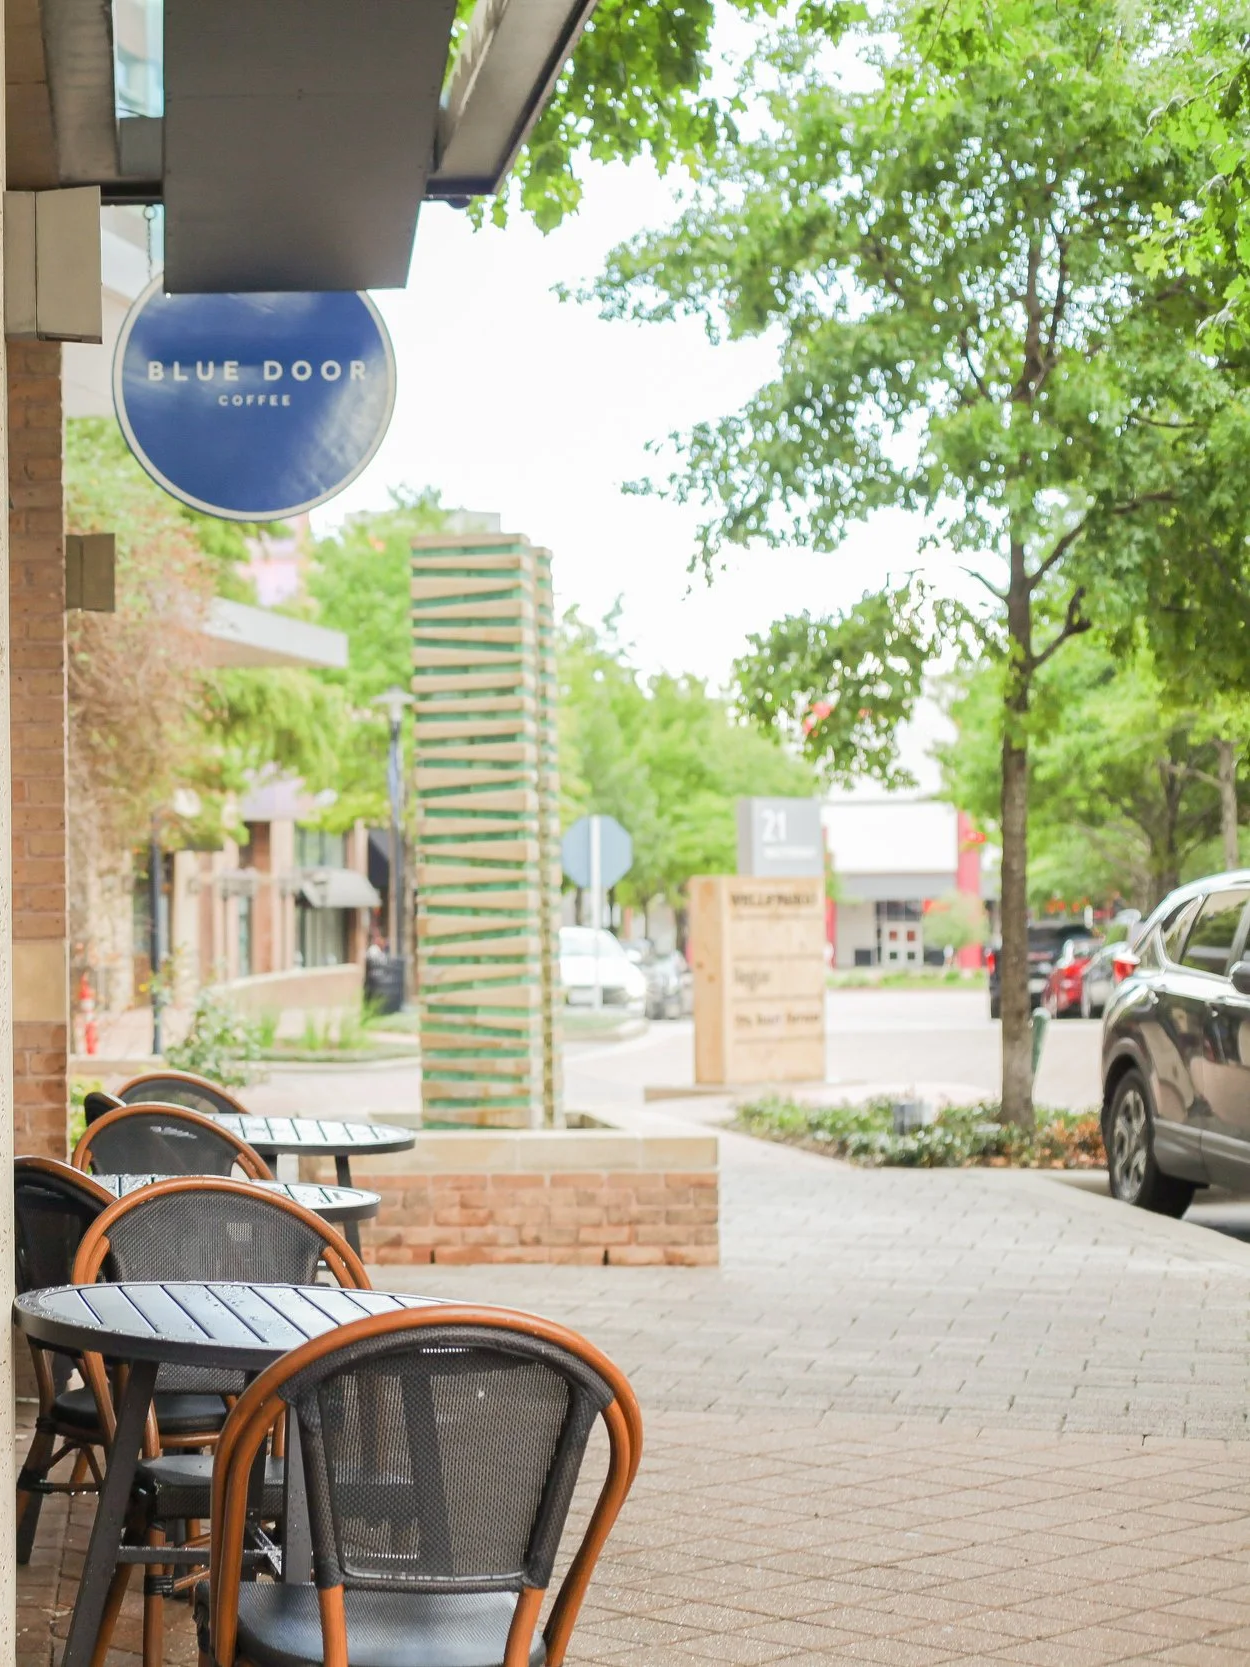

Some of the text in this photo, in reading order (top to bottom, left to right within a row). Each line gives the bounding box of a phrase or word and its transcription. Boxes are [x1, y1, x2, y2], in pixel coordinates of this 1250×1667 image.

[147, 359, 367, 382] BLUE DOOR
[218, 394, 291, 407] COFFEE
[760, 808, 787, 843] 21
